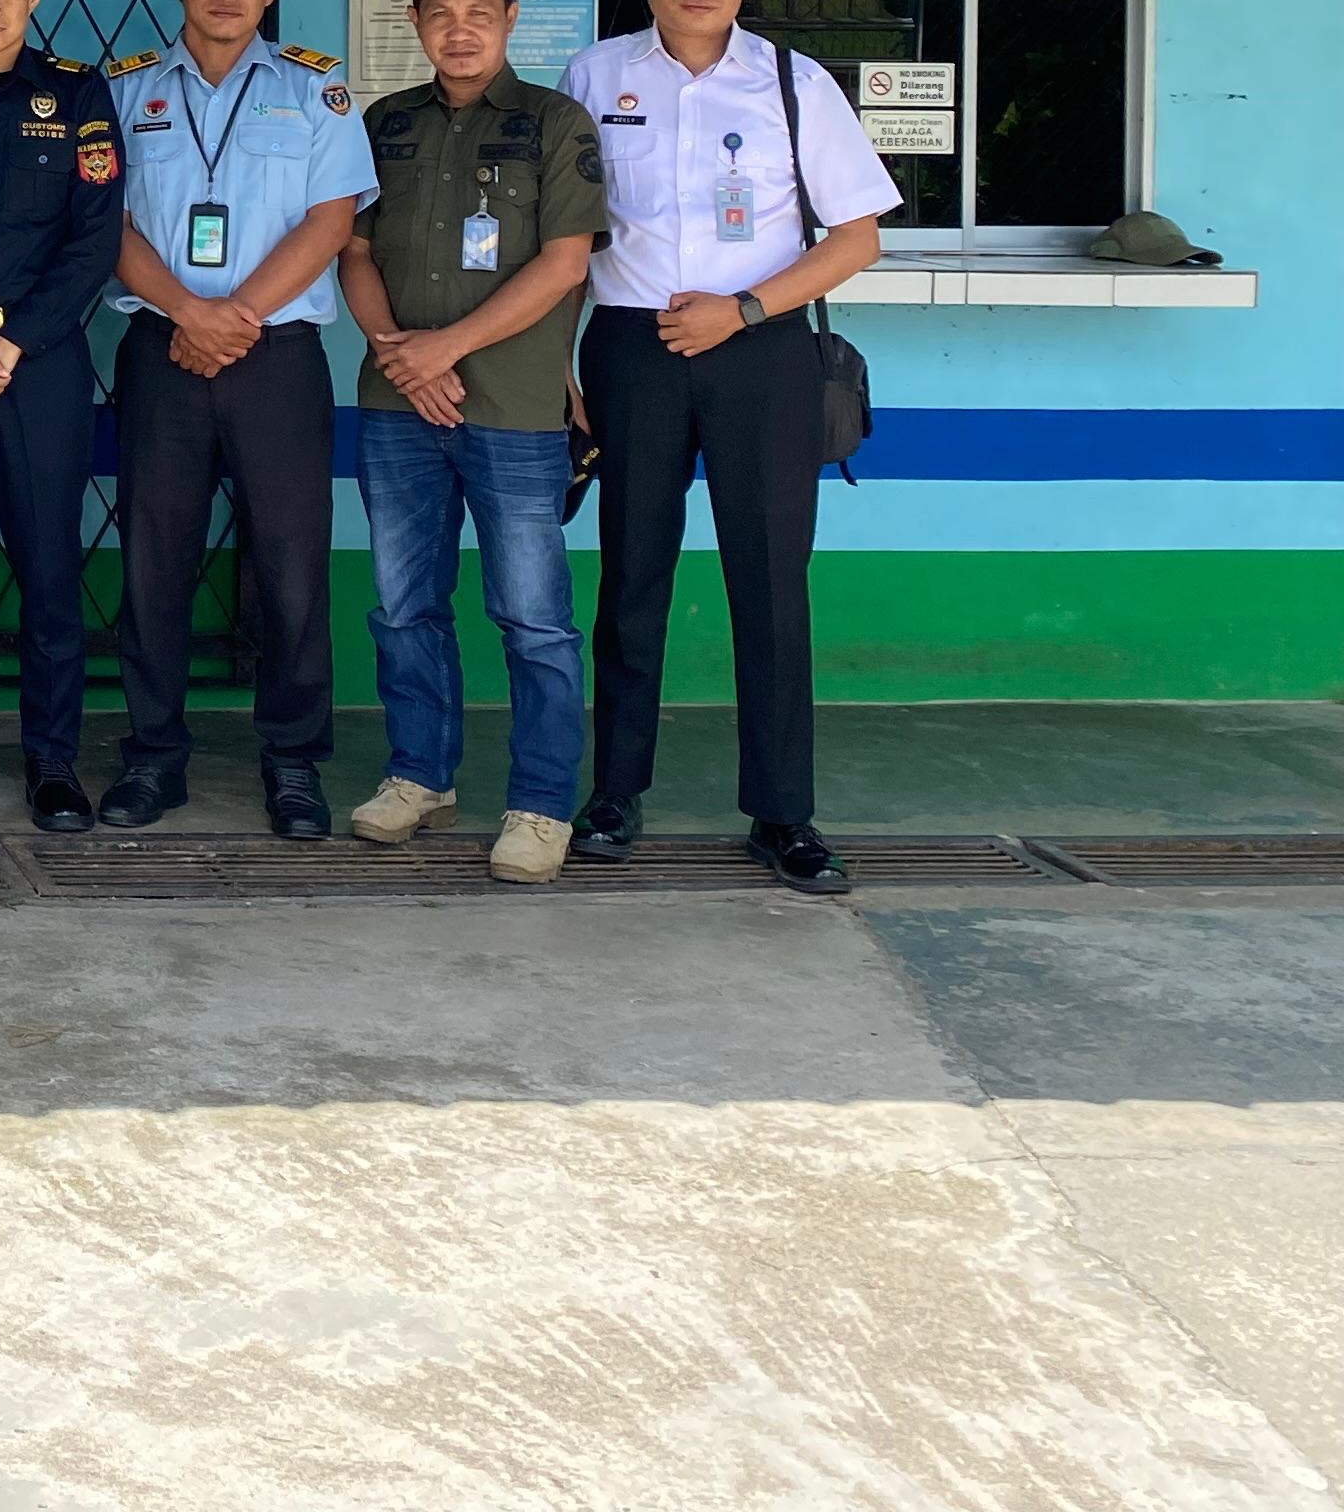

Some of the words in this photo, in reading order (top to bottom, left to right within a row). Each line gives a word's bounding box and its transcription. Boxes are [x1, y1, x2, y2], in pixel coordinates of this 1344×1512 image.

[900, 81, 944, 91] Dilarang
[900, 92, 944, 100] Merokok
[22, 122, 66, 131] CUSTOMS
[22, 130, 66, 139] EXCISE
[881, 128, 903, 136] SILA
[905, 128, 933, 136] JAGA
[872, 137, 943, 147] KEBERSIHAN
